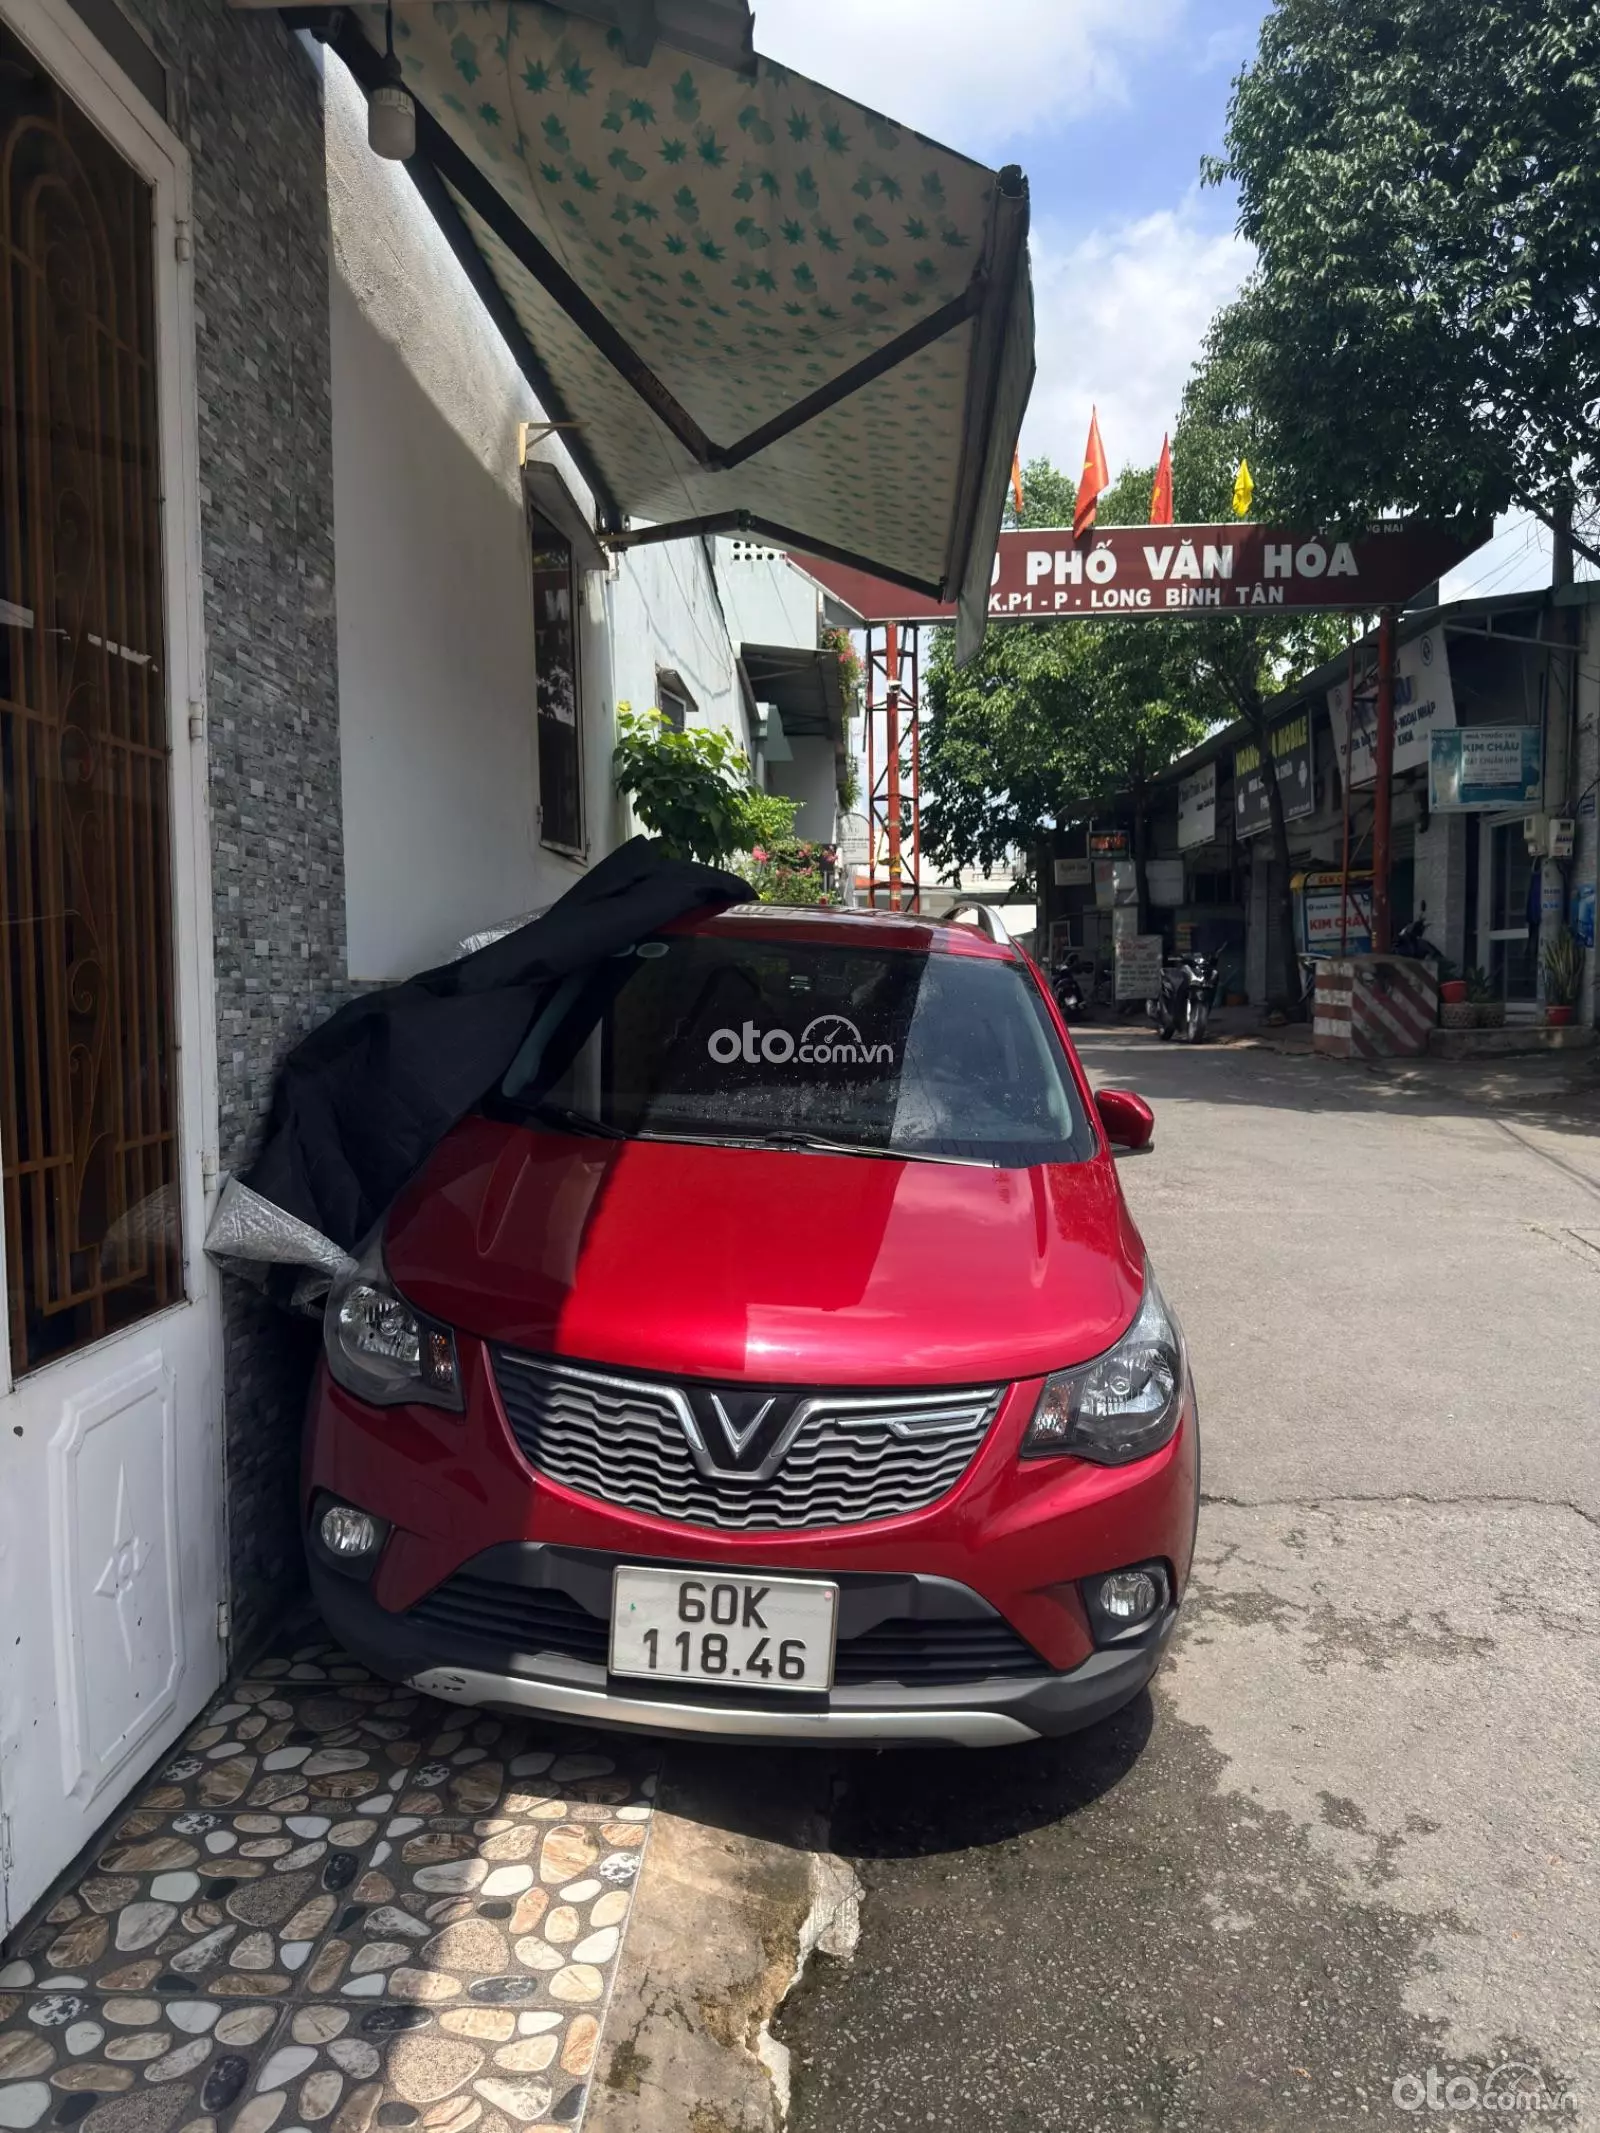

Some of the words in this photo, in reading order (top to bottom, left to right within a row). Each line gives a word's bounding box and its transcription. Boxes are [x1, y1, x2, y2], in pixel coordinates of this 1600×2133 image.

[1384, 523, 1404, 534] NAI
[1026, 538, 1118, 585] PHỐ
[1143, 538, 1233, 581] VĂN
[1264, 536, 1359, 579] HÓA
[1055, 591, 1068, 609] P
[1091, 588, 1151, 608] LONG
[1166, 583, 1220, 607] BÌNH
[1236, 582, 1284, 605] TÂN
[1463, 743, 1484, 752] KIM
[1487, 740, 1520, 752] CHÂU
[1309, 917, 1332, 931] KIM
[678, 1580, 771, 1629] 60K
[643, 1627, 807, 1680] 118.46
